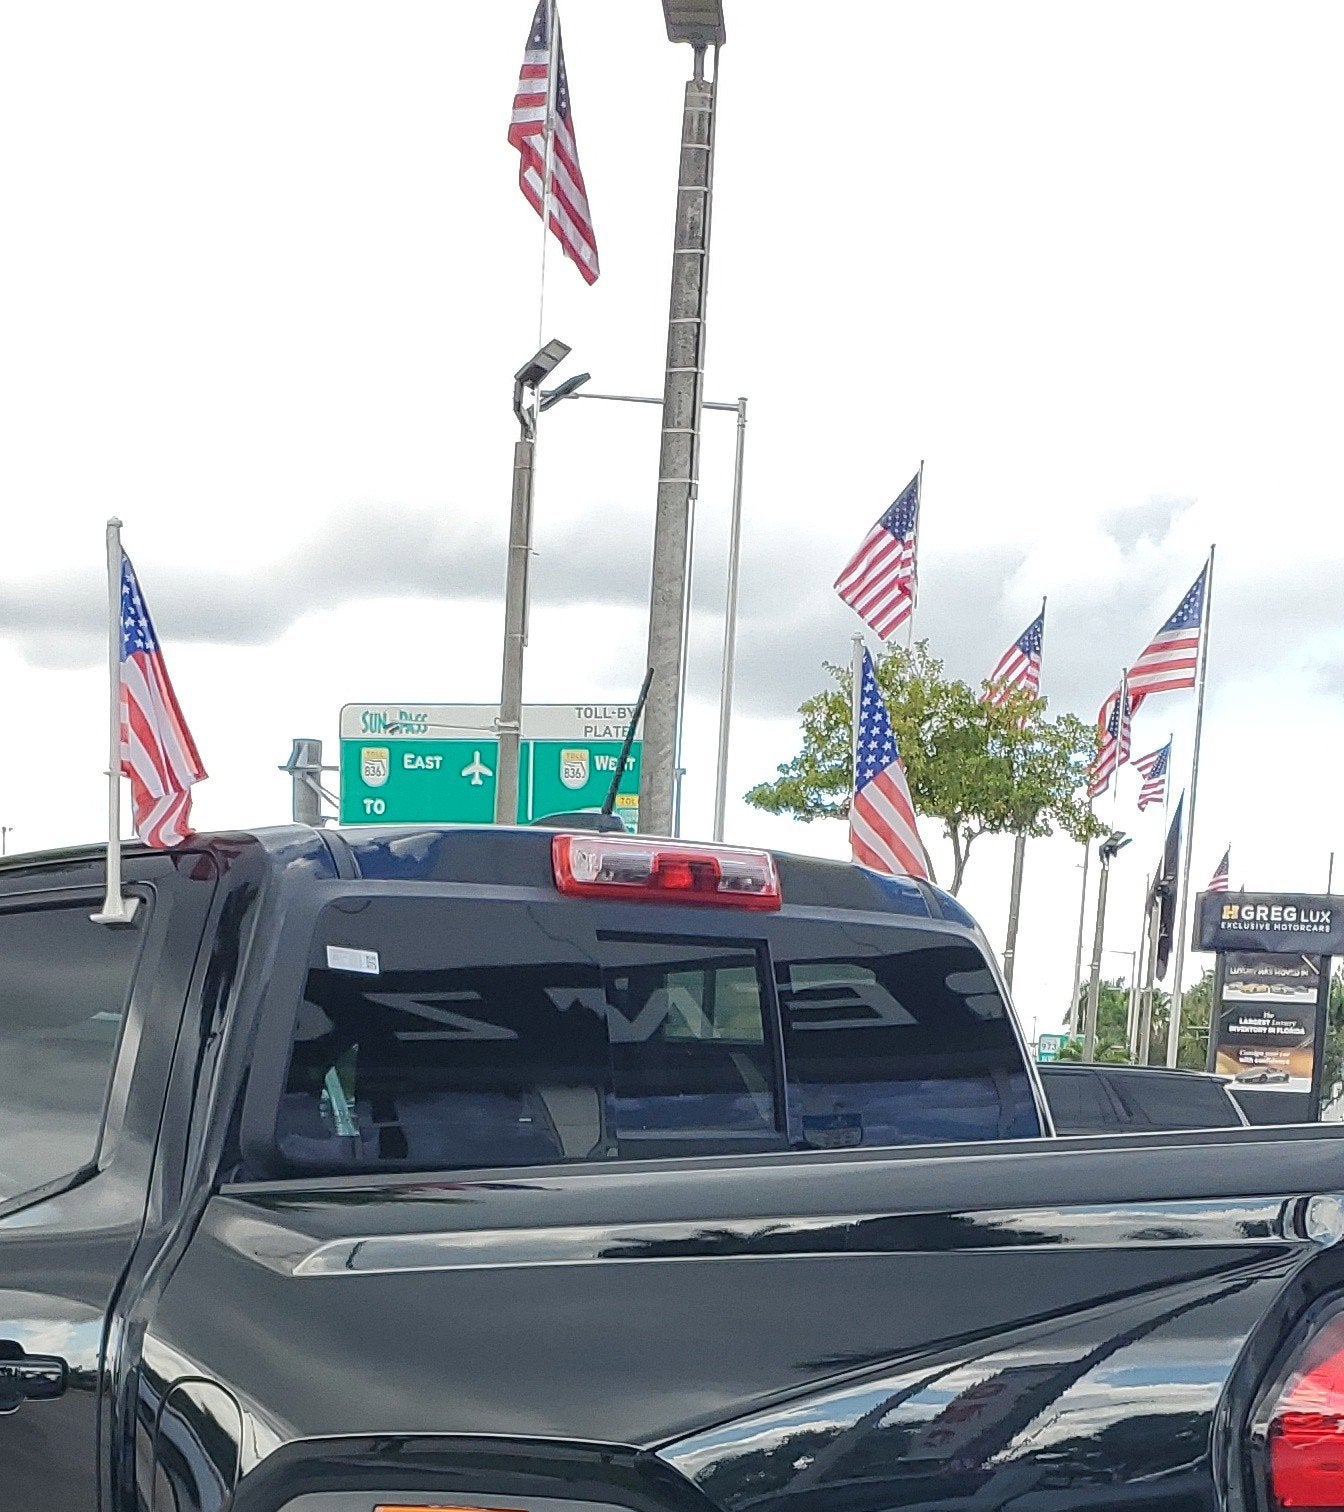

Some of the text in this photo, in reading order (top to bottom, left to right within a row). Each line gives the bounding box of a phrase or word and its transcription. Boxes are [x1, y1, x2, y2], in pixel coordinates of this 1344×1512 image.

[403, 753, 443, 770] EAST
[594, 755, 636, 771] WET
[364, 766, 382, 777] 836
[564, 768, 582, 779] 836
[363, 798, 386, 815] TO
[1300, 909, 1332, 923] LUX
[1220, 921, 1331, 933] EXCLUSIVE MOTORCARS
